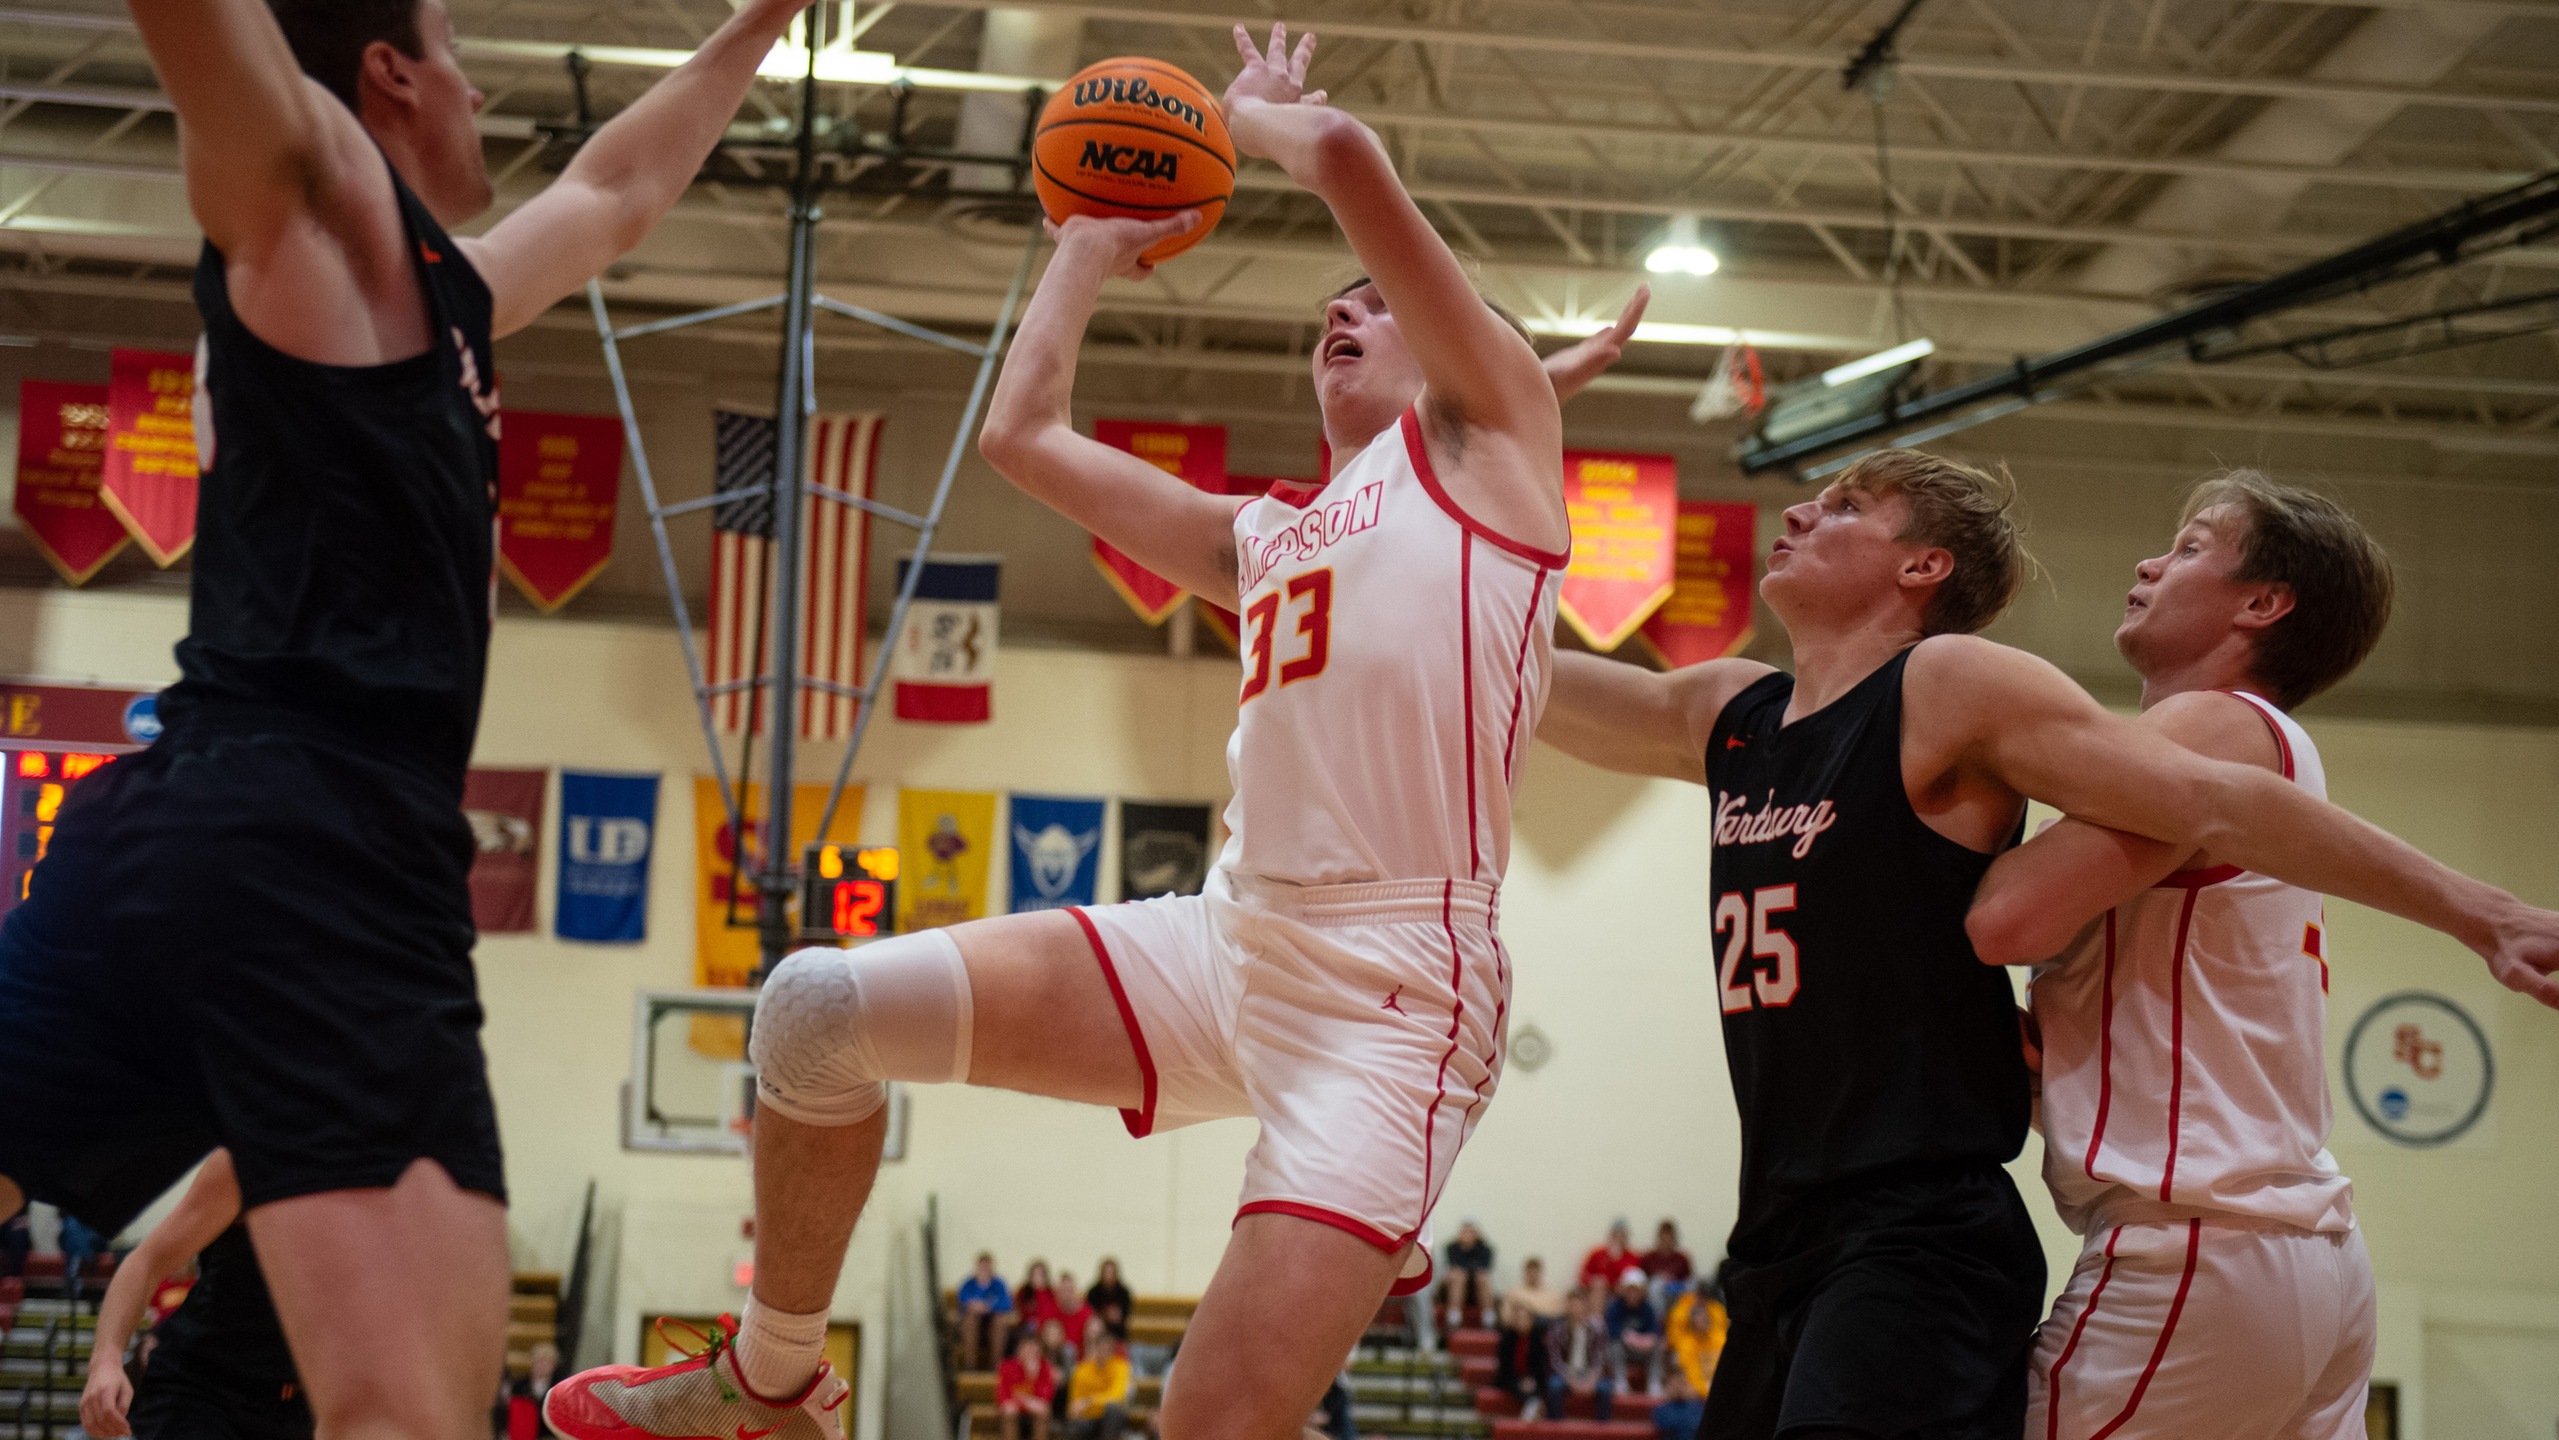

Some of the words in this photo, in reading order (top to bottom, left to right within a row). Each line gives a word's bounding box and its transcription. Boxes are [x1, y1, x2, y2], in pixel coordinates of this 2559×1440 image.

[1073, 78, 1205, 135] Wilson
[1079, 140, 1177, 183] NCAA
[1239, 566, 1334, 707] 33
[568, 814, 649, 866] UD
[833, 880, 884, 937] 12
[1715, 882, 1801, 1014] 25
